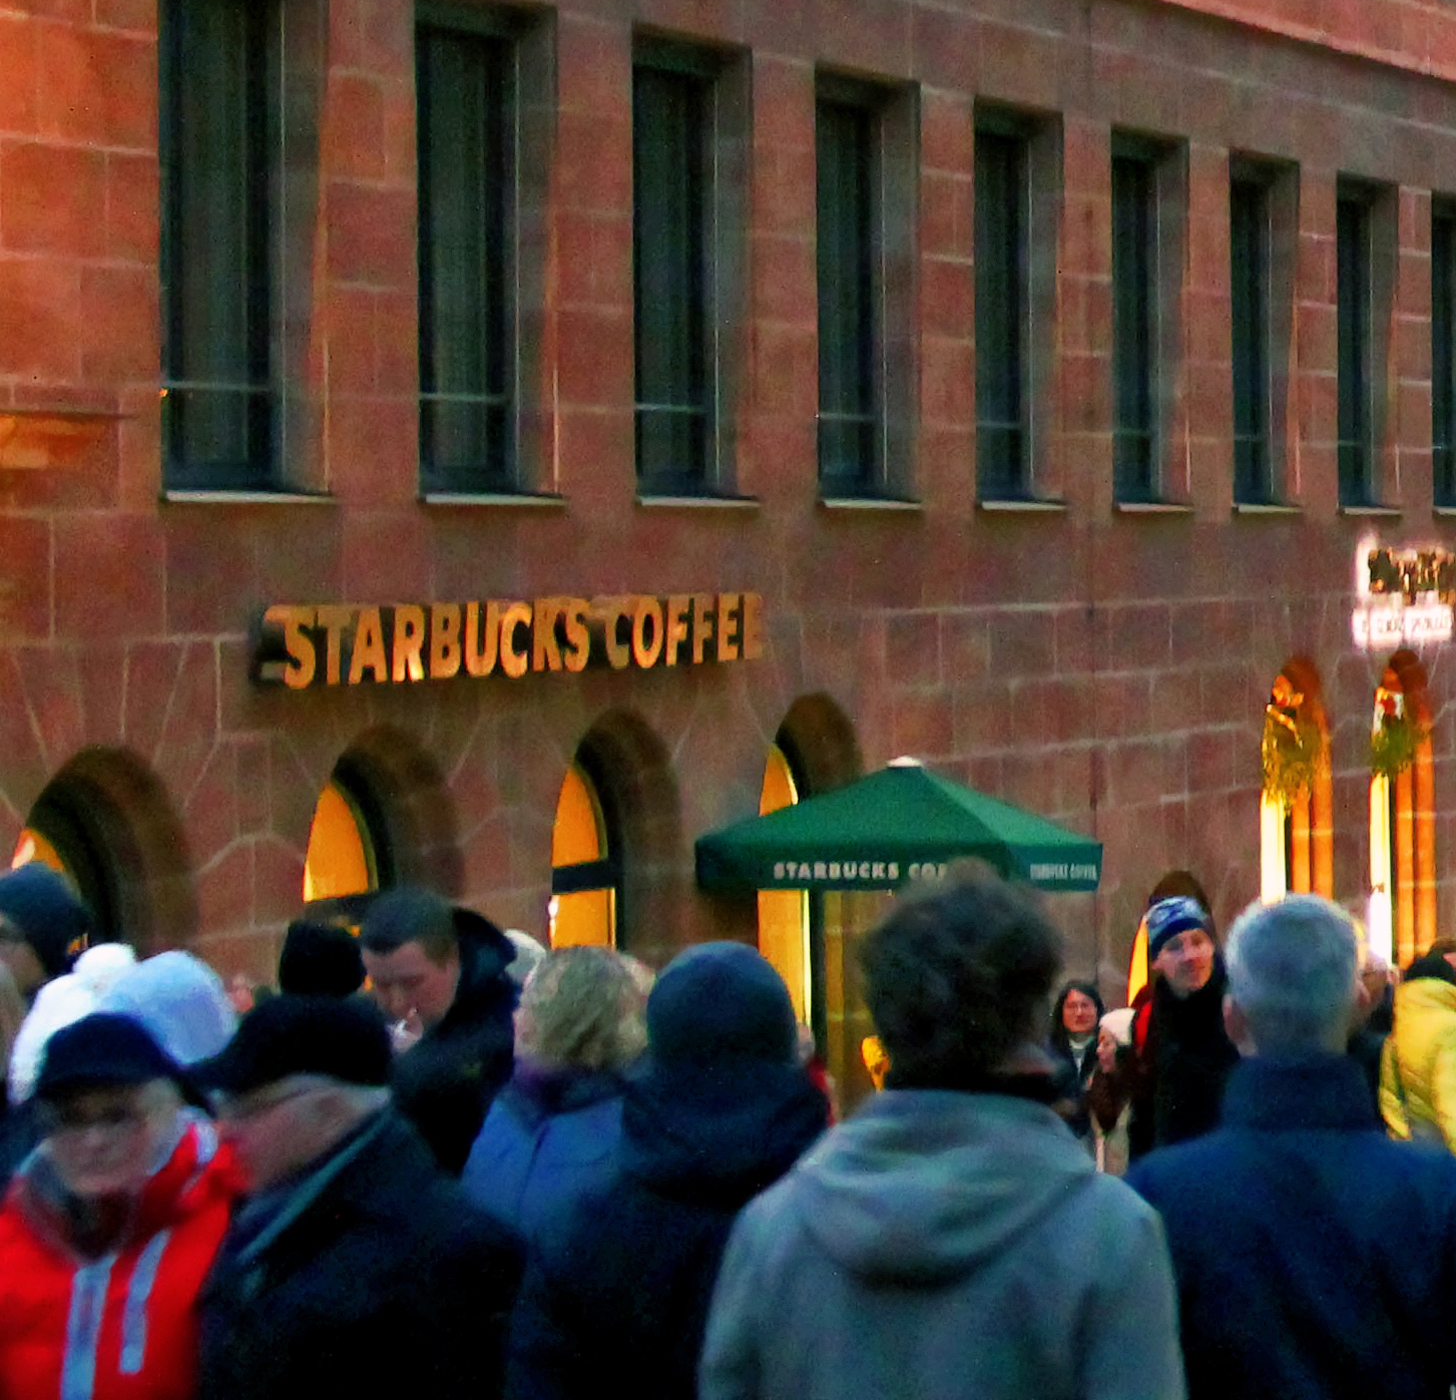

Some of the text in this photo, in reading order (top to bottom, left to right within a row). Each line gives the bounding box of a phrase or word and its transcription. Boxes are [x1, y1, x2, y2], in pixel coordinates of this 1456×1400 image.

[264, 592, 764, 690] STARBUCKS COFFEE
[774, 861, 899, 881] STARBUCKS
